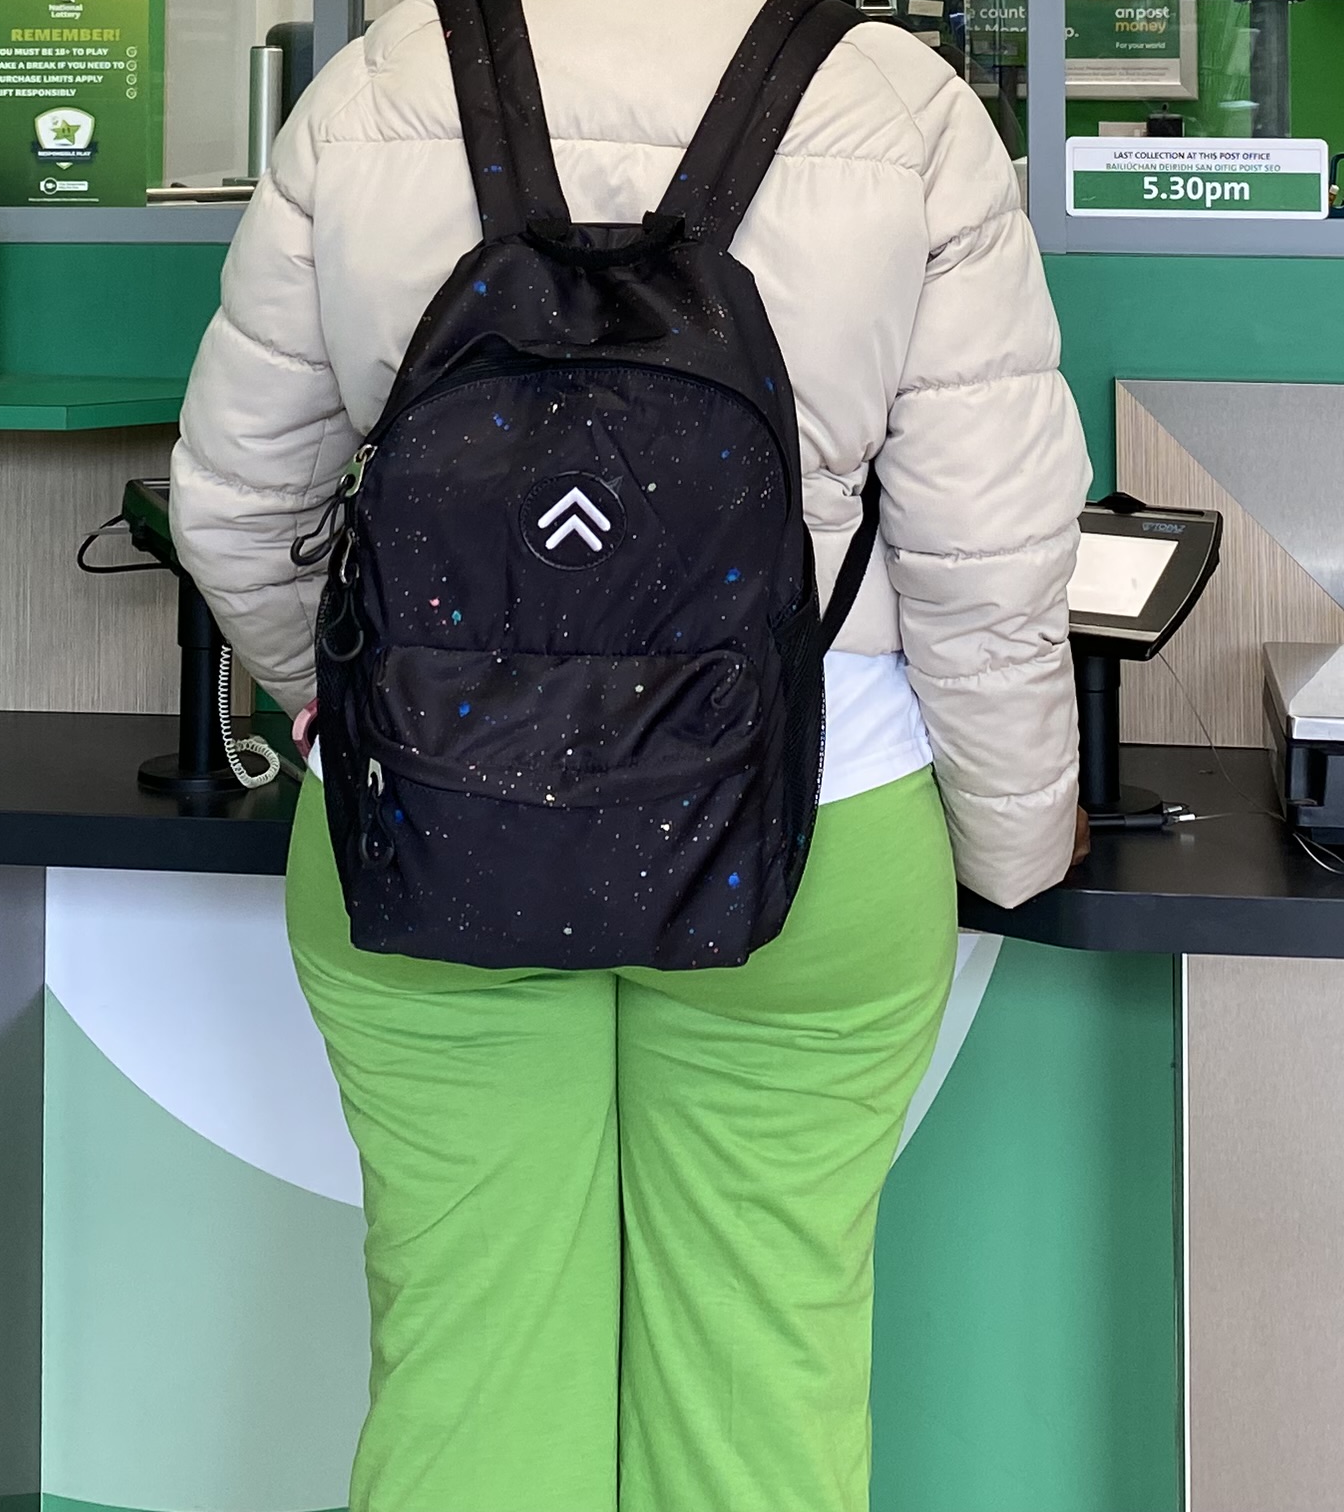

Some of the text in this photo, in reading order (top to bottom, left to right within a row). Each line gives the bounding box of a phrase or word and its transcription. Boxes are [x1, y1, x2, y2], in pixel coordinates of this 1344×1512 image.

[1115, 21, 1166, 33] money
[11, 29, 120, 41] REMEMBER!
[14, 48, 40, 56] MUST
[42, 48, 53, 56] BE
[55, 48, 70, 56] 18+
[72, 48, 84, 56] TO
[86, 48, 108, 56] PLAY
[44, 75, 73, 83] LIMITS
[75, 75, 103, 83] APPLY
[15, 89, 76, 97] RESPONSIBLY
[1114, 152, 1271, 160] LAST COLLECTION AT THIS POST OFFICE
[1143, 176, 1250, 207] 5.30pm
